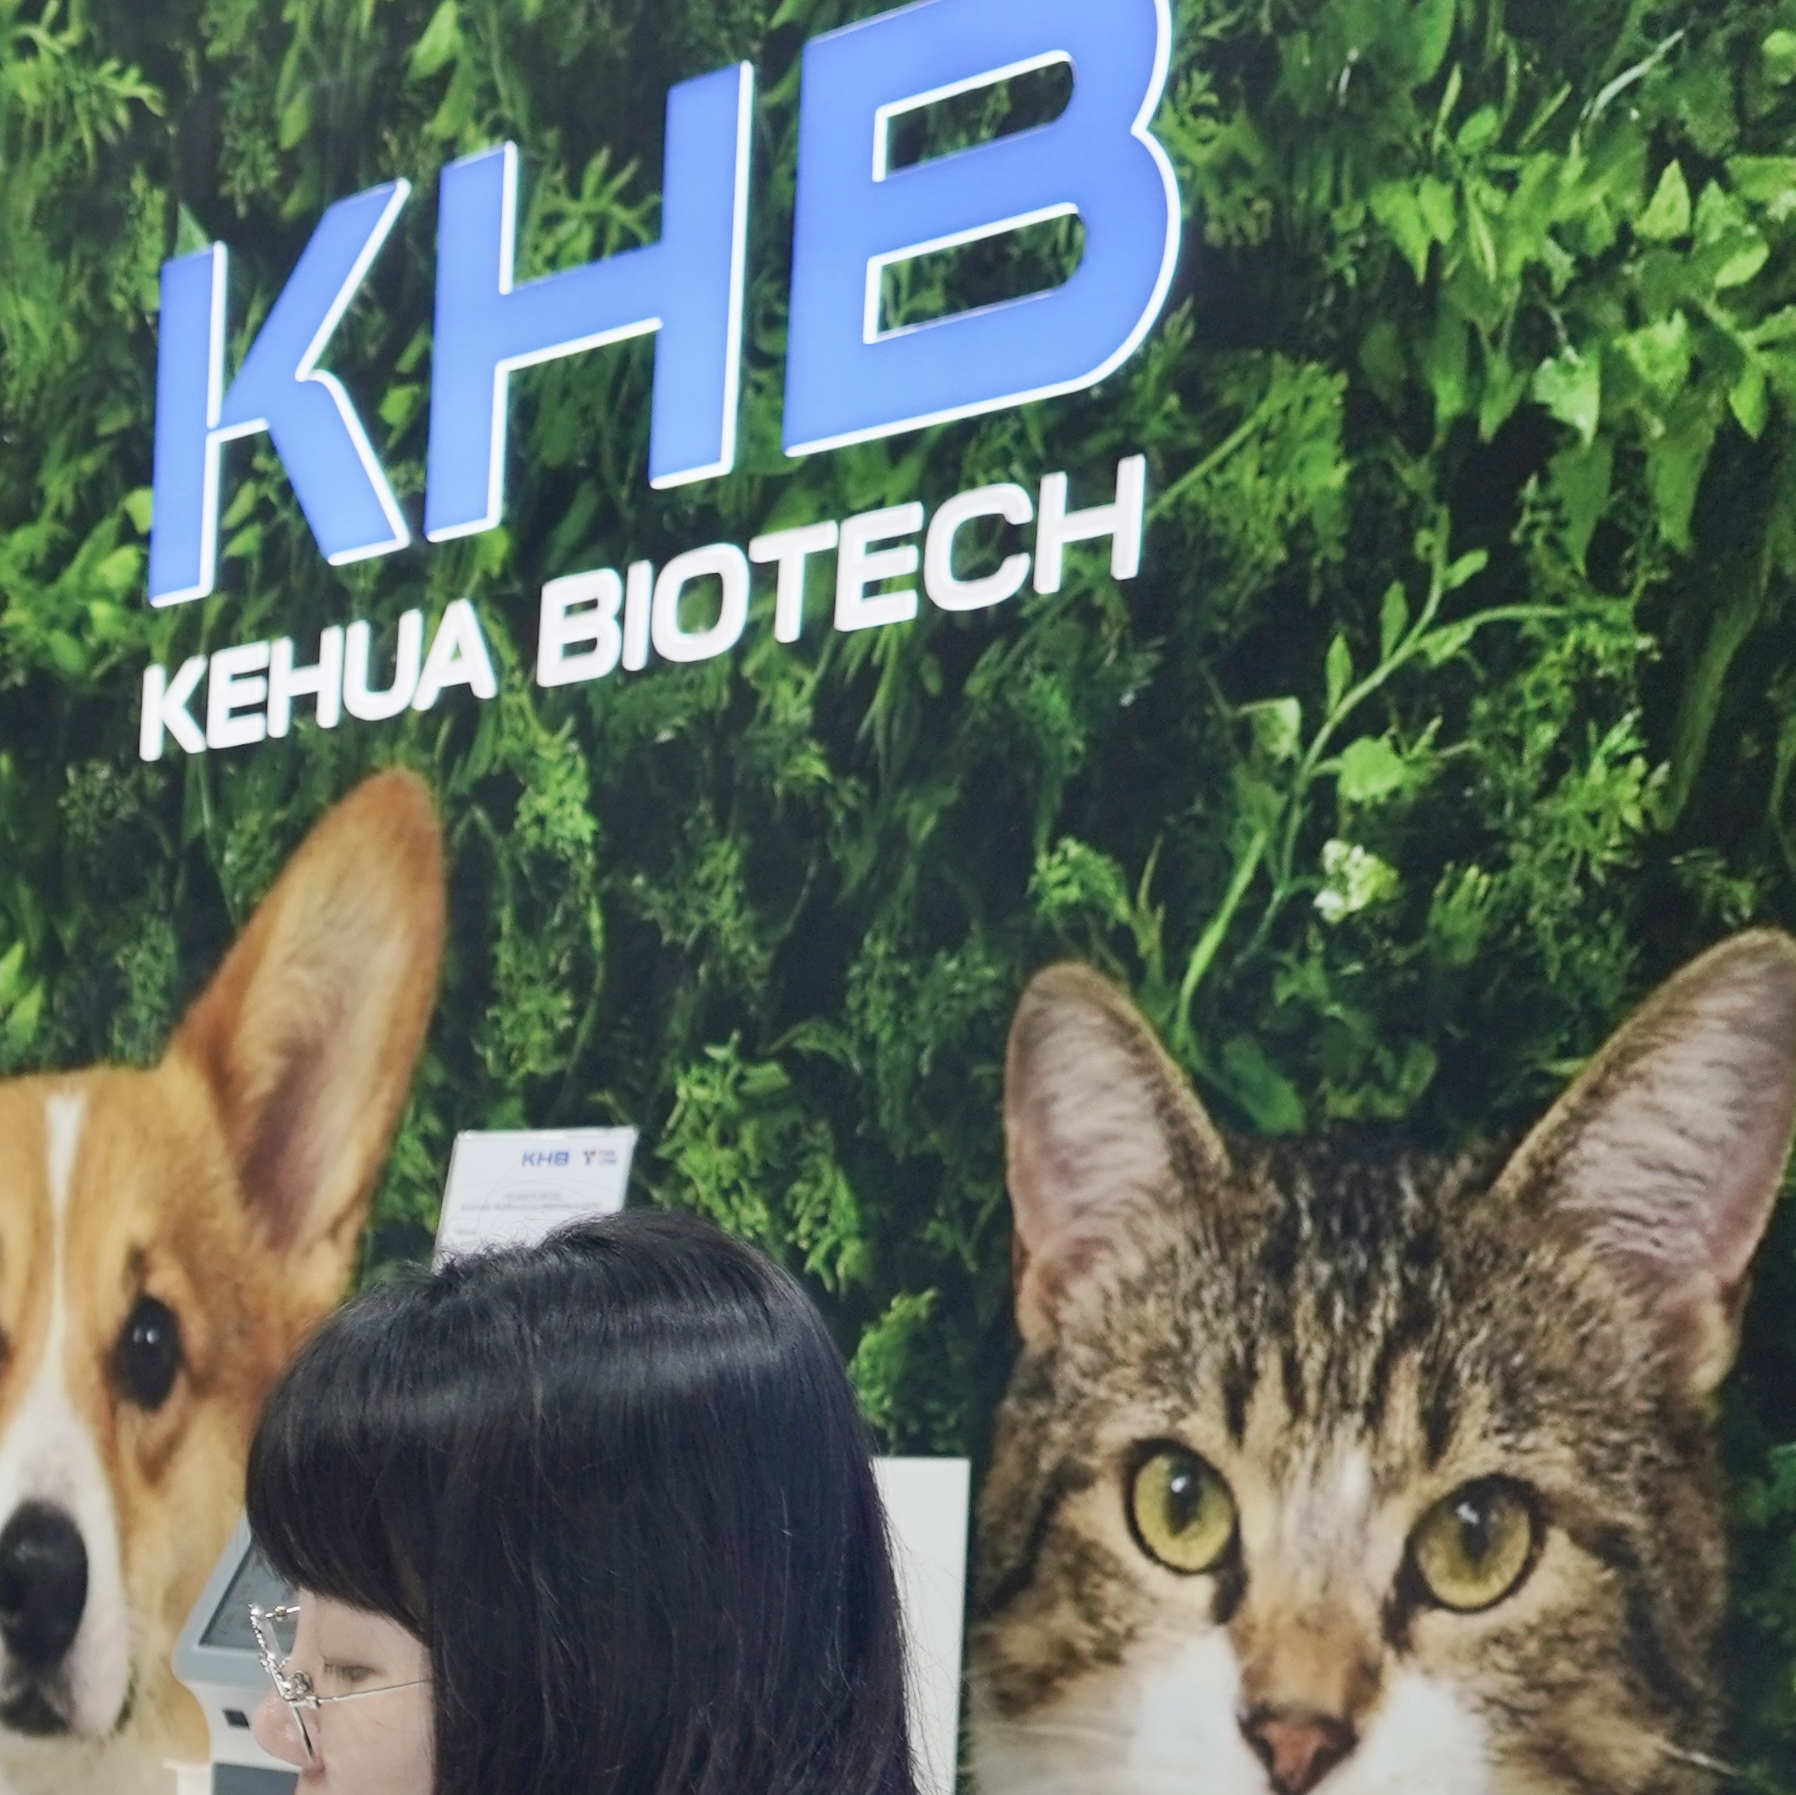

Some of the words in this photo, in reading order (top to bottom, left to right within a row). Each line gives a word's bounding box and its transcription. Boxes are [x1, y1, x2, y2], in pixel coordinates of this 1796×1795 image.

[149, 0, 1183, 608] KHB
[139, 598, 498, 762] KEHUA
[535, 454, 1146, 689] BIOTECH
